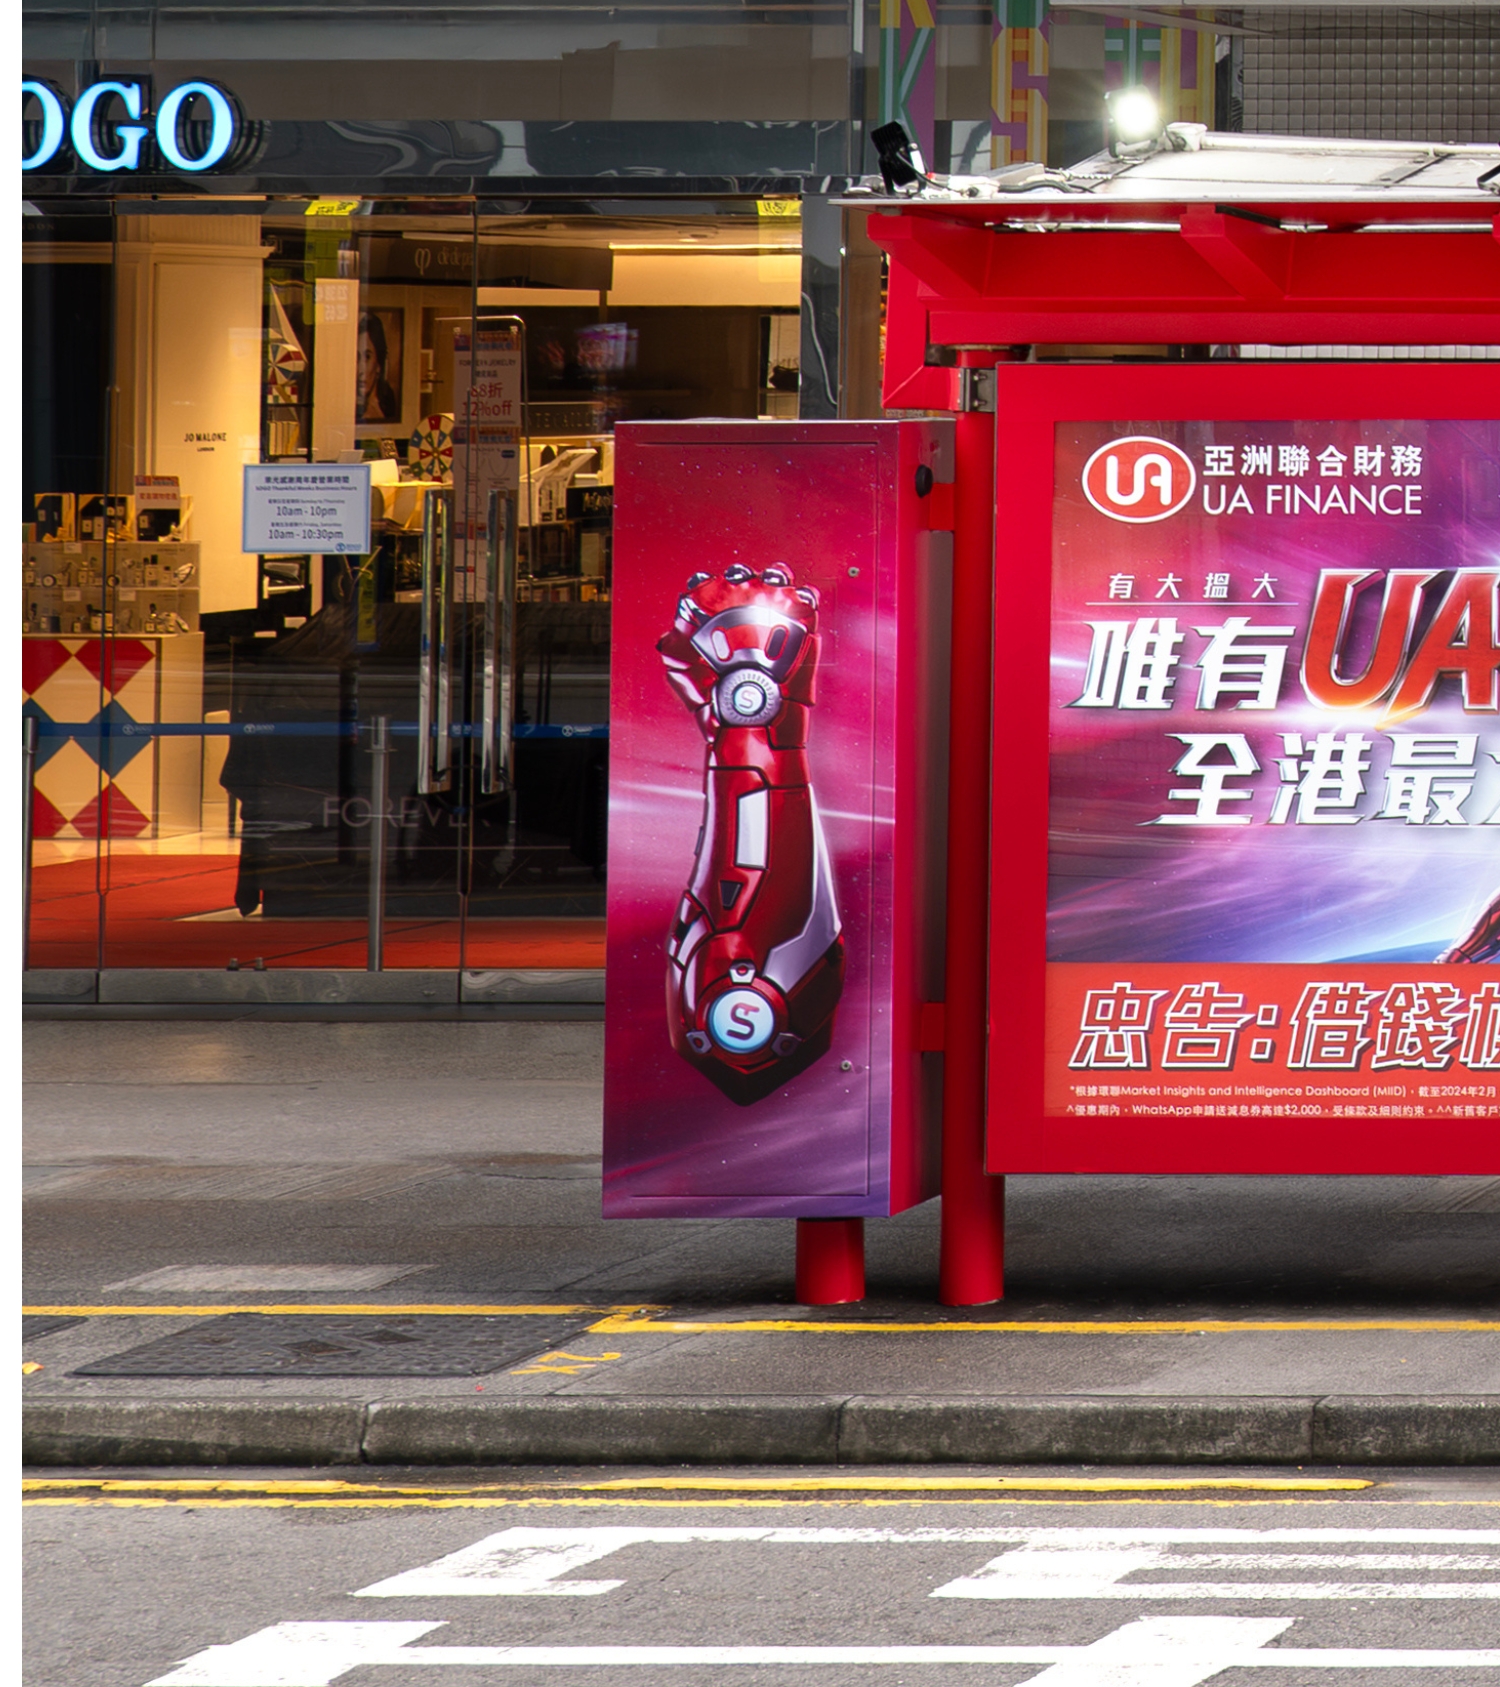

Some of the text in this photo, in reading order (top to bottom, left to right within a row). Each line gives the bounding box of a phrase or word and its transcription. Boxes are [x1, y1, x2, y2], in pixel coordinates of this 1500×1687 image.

[196, 432, 227, 442] MALONE
[1203, 444, 1423, 477] 亞洲聯合財務
[1203, 485, 1422, 515] UA FINANCE
[276, 506, 304, 517] 10am
[310, 506, 338, 518] 10pm
[268, 529, 295, 540] 10am
[1108, 573, 1279, 599] 有大搵大
[1061, 616, 1298, 712] 唯有
[1163, 1086, 1206, 1098] Insights
[1208, 1086, 1232, 1096] and
[1234, 1086, 1303, 1098] Intelligence
[1305, 1086, 1370, 1097] Dashboard
